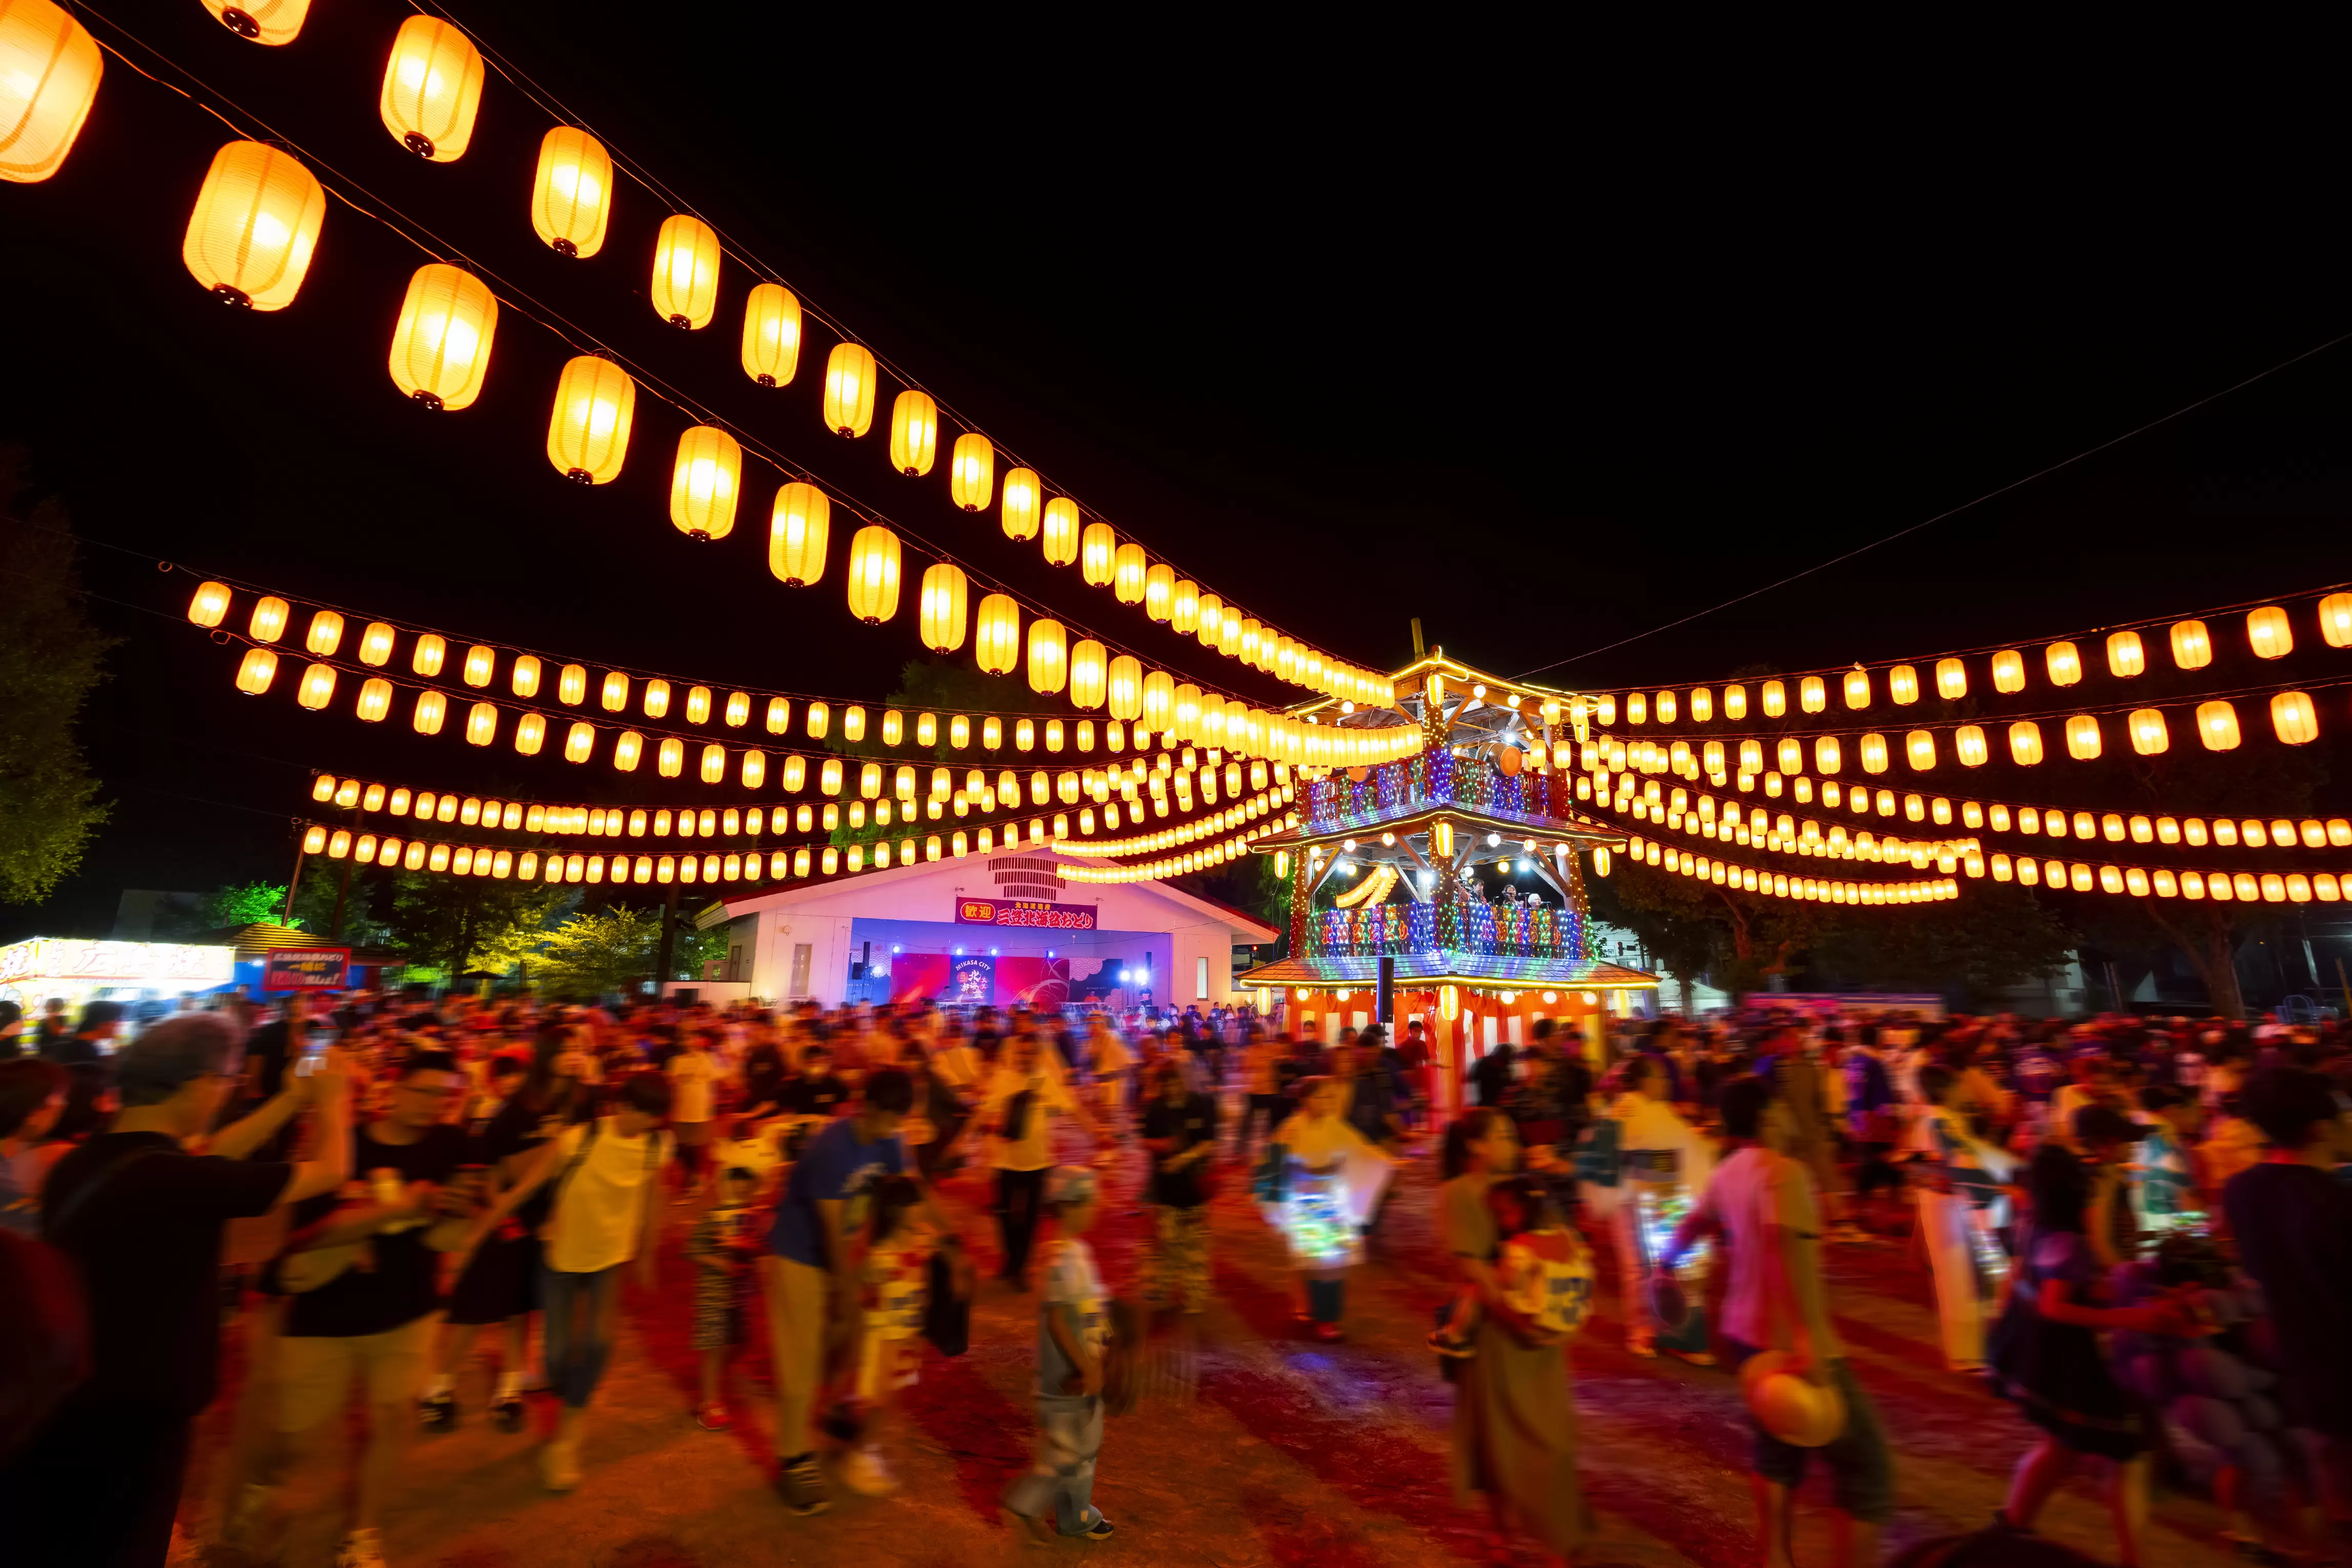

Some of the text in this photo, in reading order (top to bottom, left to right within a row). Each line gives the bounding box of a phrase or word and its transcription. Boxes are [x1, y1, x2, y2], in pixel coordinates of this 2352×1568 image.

[965, 905, 991, 918] 歓迎
[1015, 902, 1051, 910] 北海道遺産
[997, 908, 1093, 929] 三笠北海盆おどり
[955, 960, 991, 971] MIKASA CITY
